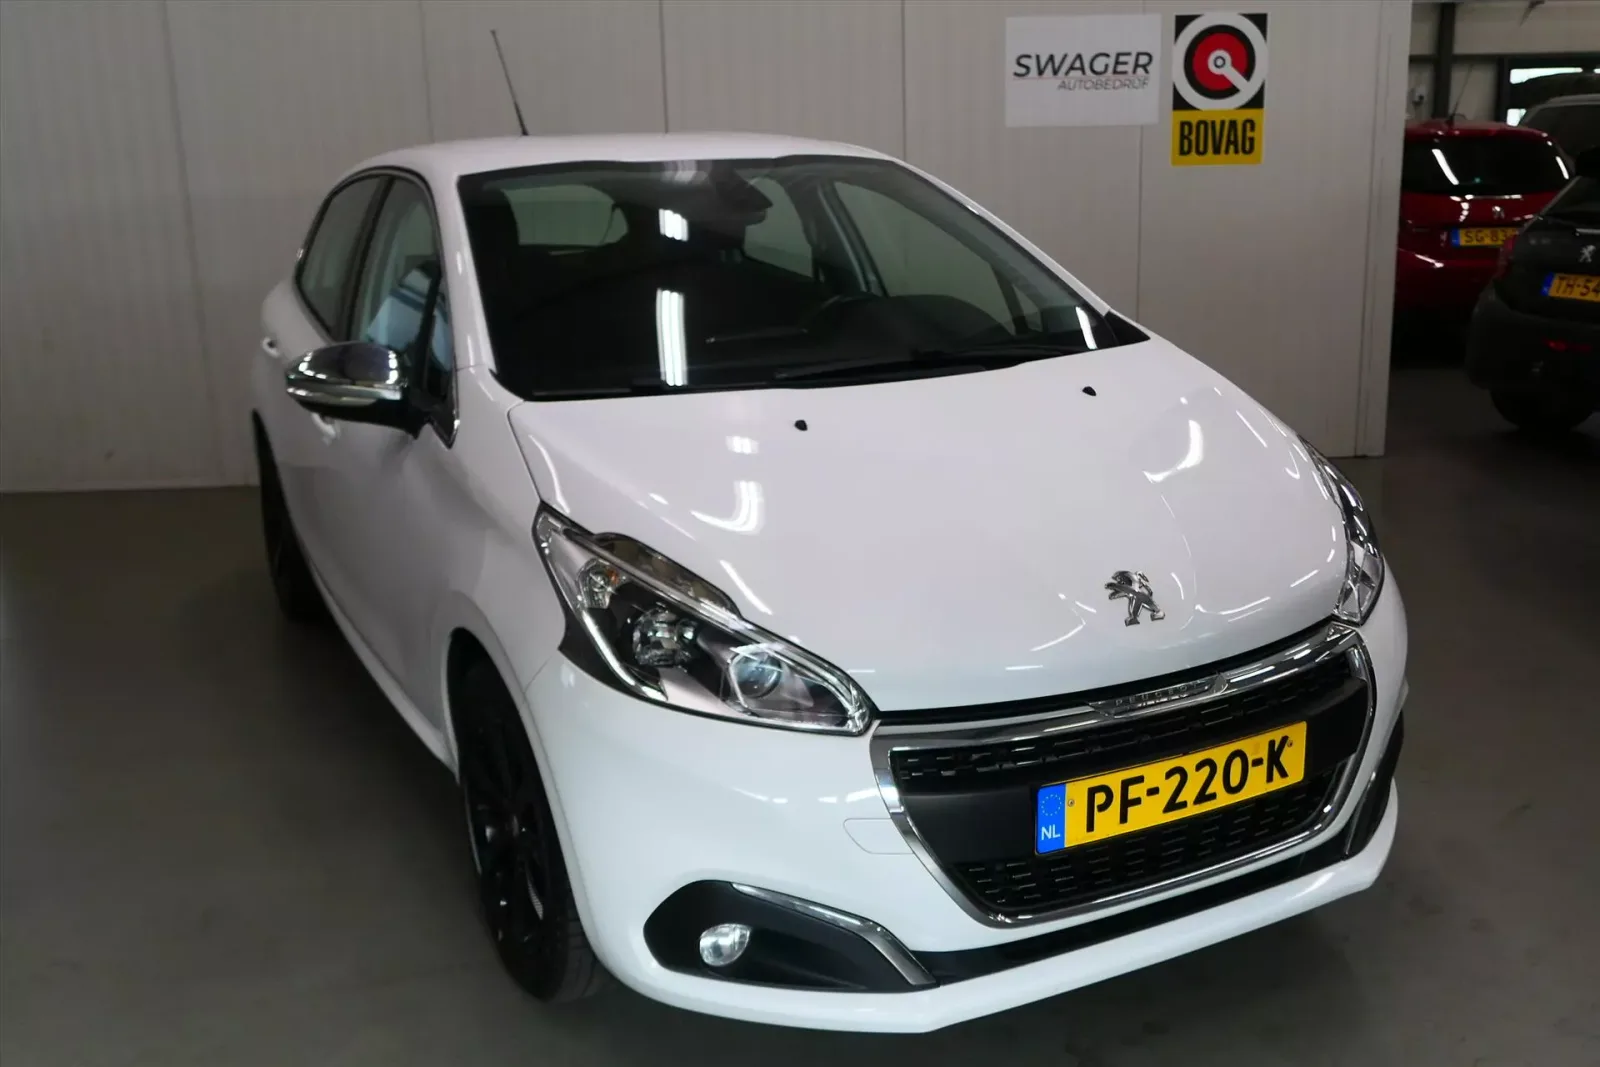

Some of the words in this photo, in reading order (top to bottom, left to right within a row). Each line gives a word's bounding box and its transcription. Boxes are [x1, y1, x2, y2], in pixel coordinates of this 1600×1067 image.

[1013, 51, 1153, 78] SWAGER
[1057, 76, 1150, 91] AUTOBEDRIJF
[1179, 118, 1256, 156] BOVAG
[1464, 228, 1514, 243] SG-83
[1086, 735, 1290, 833] PF-220-K
[1041, 824, 1060, 840] NL
